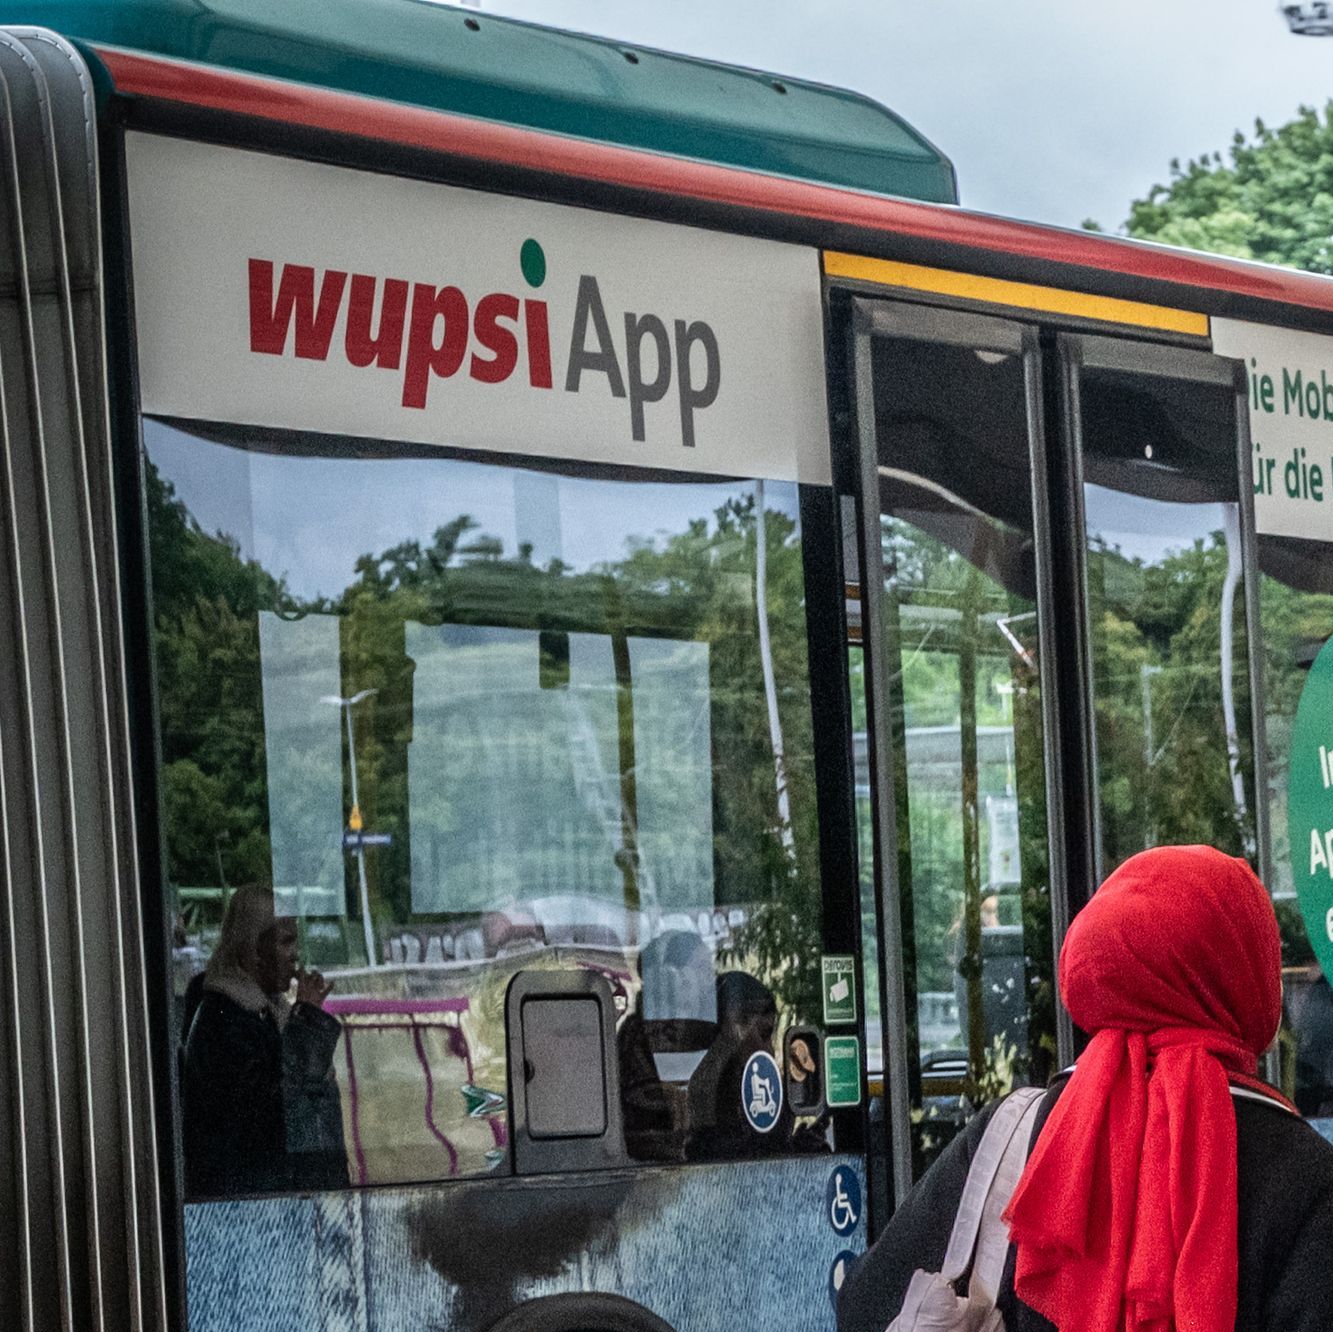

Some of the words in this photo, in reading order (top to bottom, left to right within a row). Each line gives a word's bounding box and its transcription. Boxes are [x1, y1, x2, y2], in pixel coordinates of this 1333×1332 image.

[1251, 357, 1275, 413] ie
[1252, 443, 1276, 496] ür
[1284, 448, 1323, 502] die
